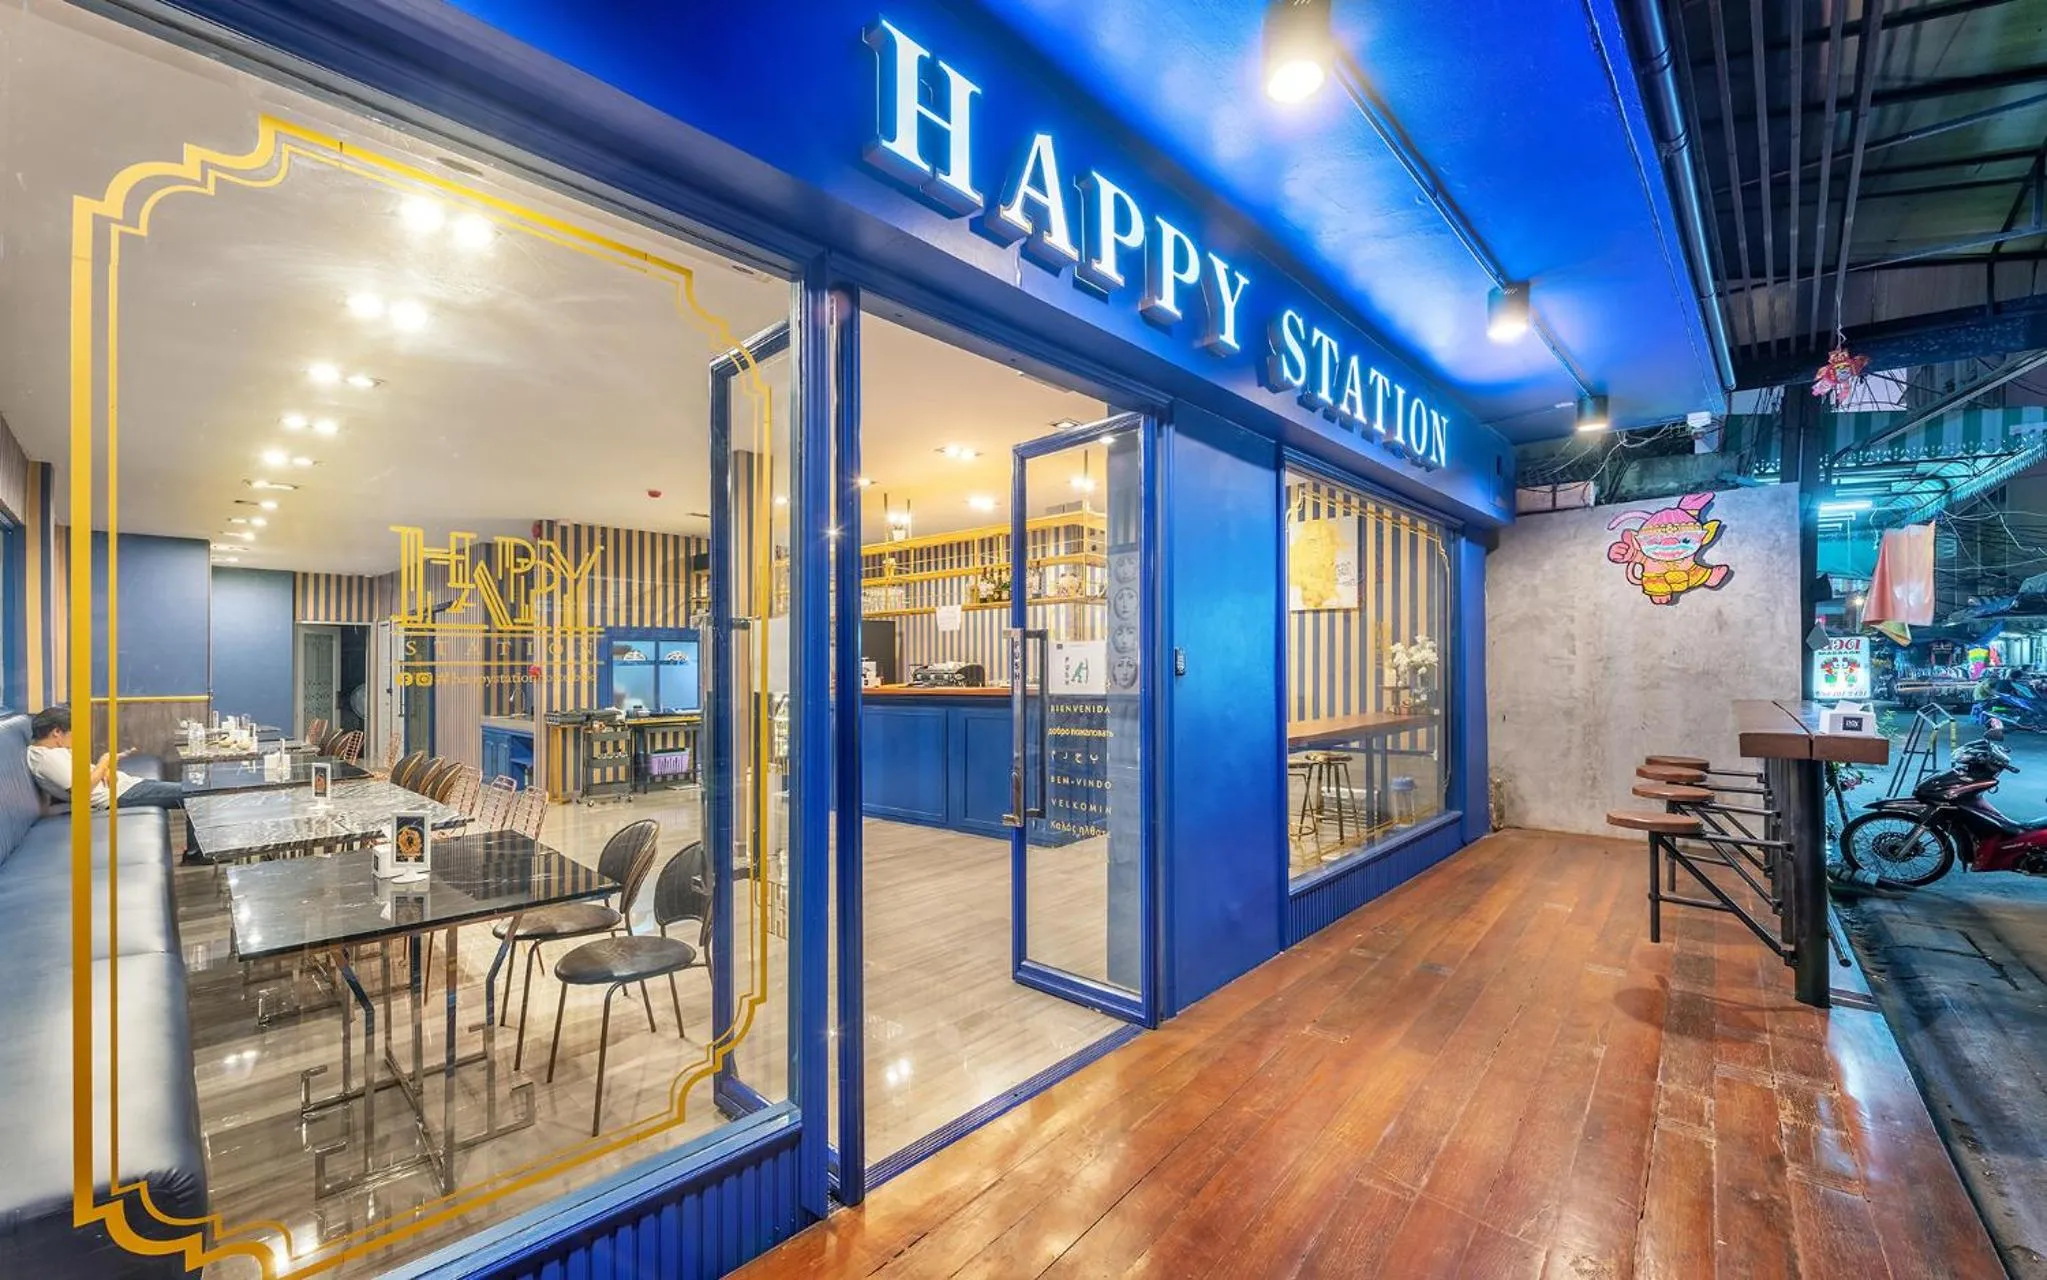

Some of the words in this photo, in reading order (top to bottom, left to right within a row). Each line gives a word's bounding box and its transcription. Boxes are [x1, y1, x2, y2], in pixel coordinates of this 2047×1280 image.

[870, 18, 1250, 352] HAPPY
[1274, 308, 1451, 469] STATION
[404, 640, 595, 657] STATION
[1050, 704, 1112, 714] BIENVENIDA
[1050, 797, 1113, 816] VELKOMIN
